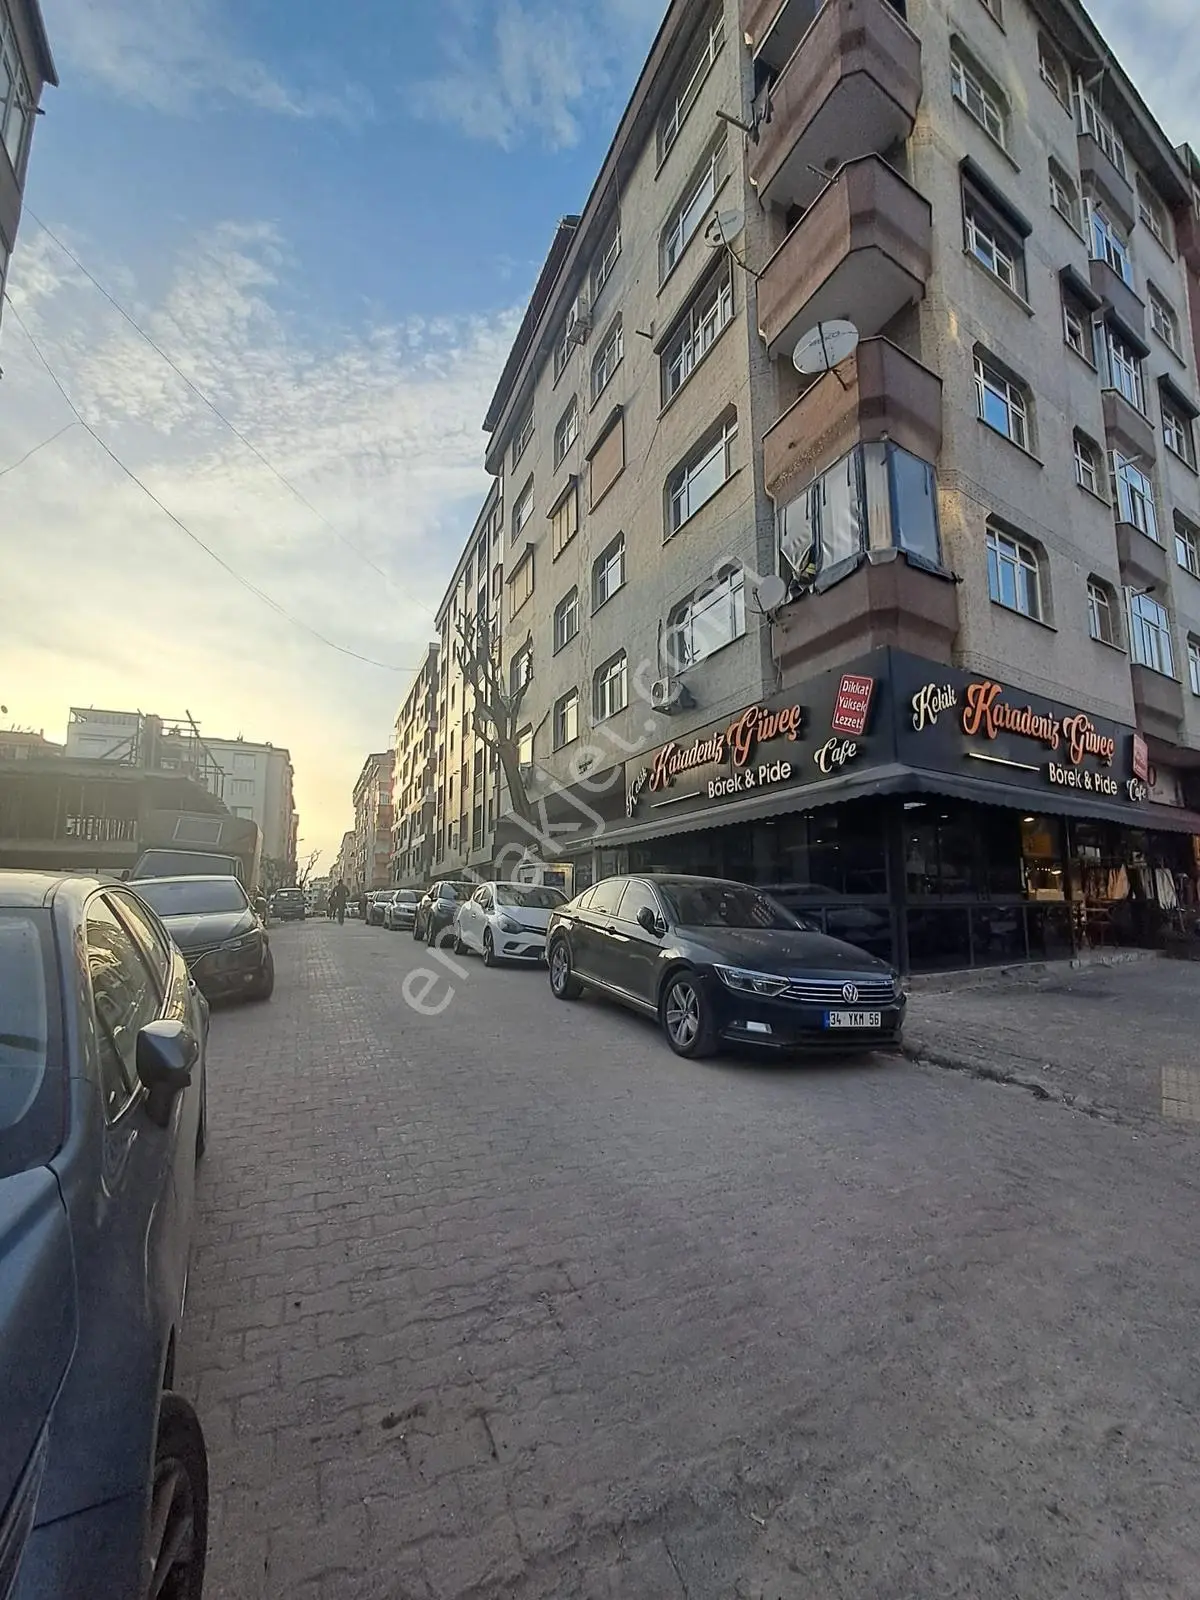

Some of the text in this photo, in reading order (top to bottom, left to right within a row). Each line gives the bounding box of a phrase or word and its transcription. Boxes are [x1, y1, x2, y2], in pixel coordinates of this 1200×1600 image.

[839, 696, 867, 712] Yüksek
[842, 680, 869, 696] Dikkat
[912, 683, 957, 732] Kekik
[963, 681, 1060, 750] Karadeniz
[1063, 714, 1115, 767] Güveç
[648, 732, 725, 792] Karadeniz
[727, 704, 802, 766] Güveç
[813, 737, 857, 774] Cafe
[708, 760, 792, 799] Börek & Pide
[1049, 762, 1118, 795] Börek & Pide
[1126, 778, 1147, 801] Cafe
[831, 1013, 879, 1025] 34 YKM 56
